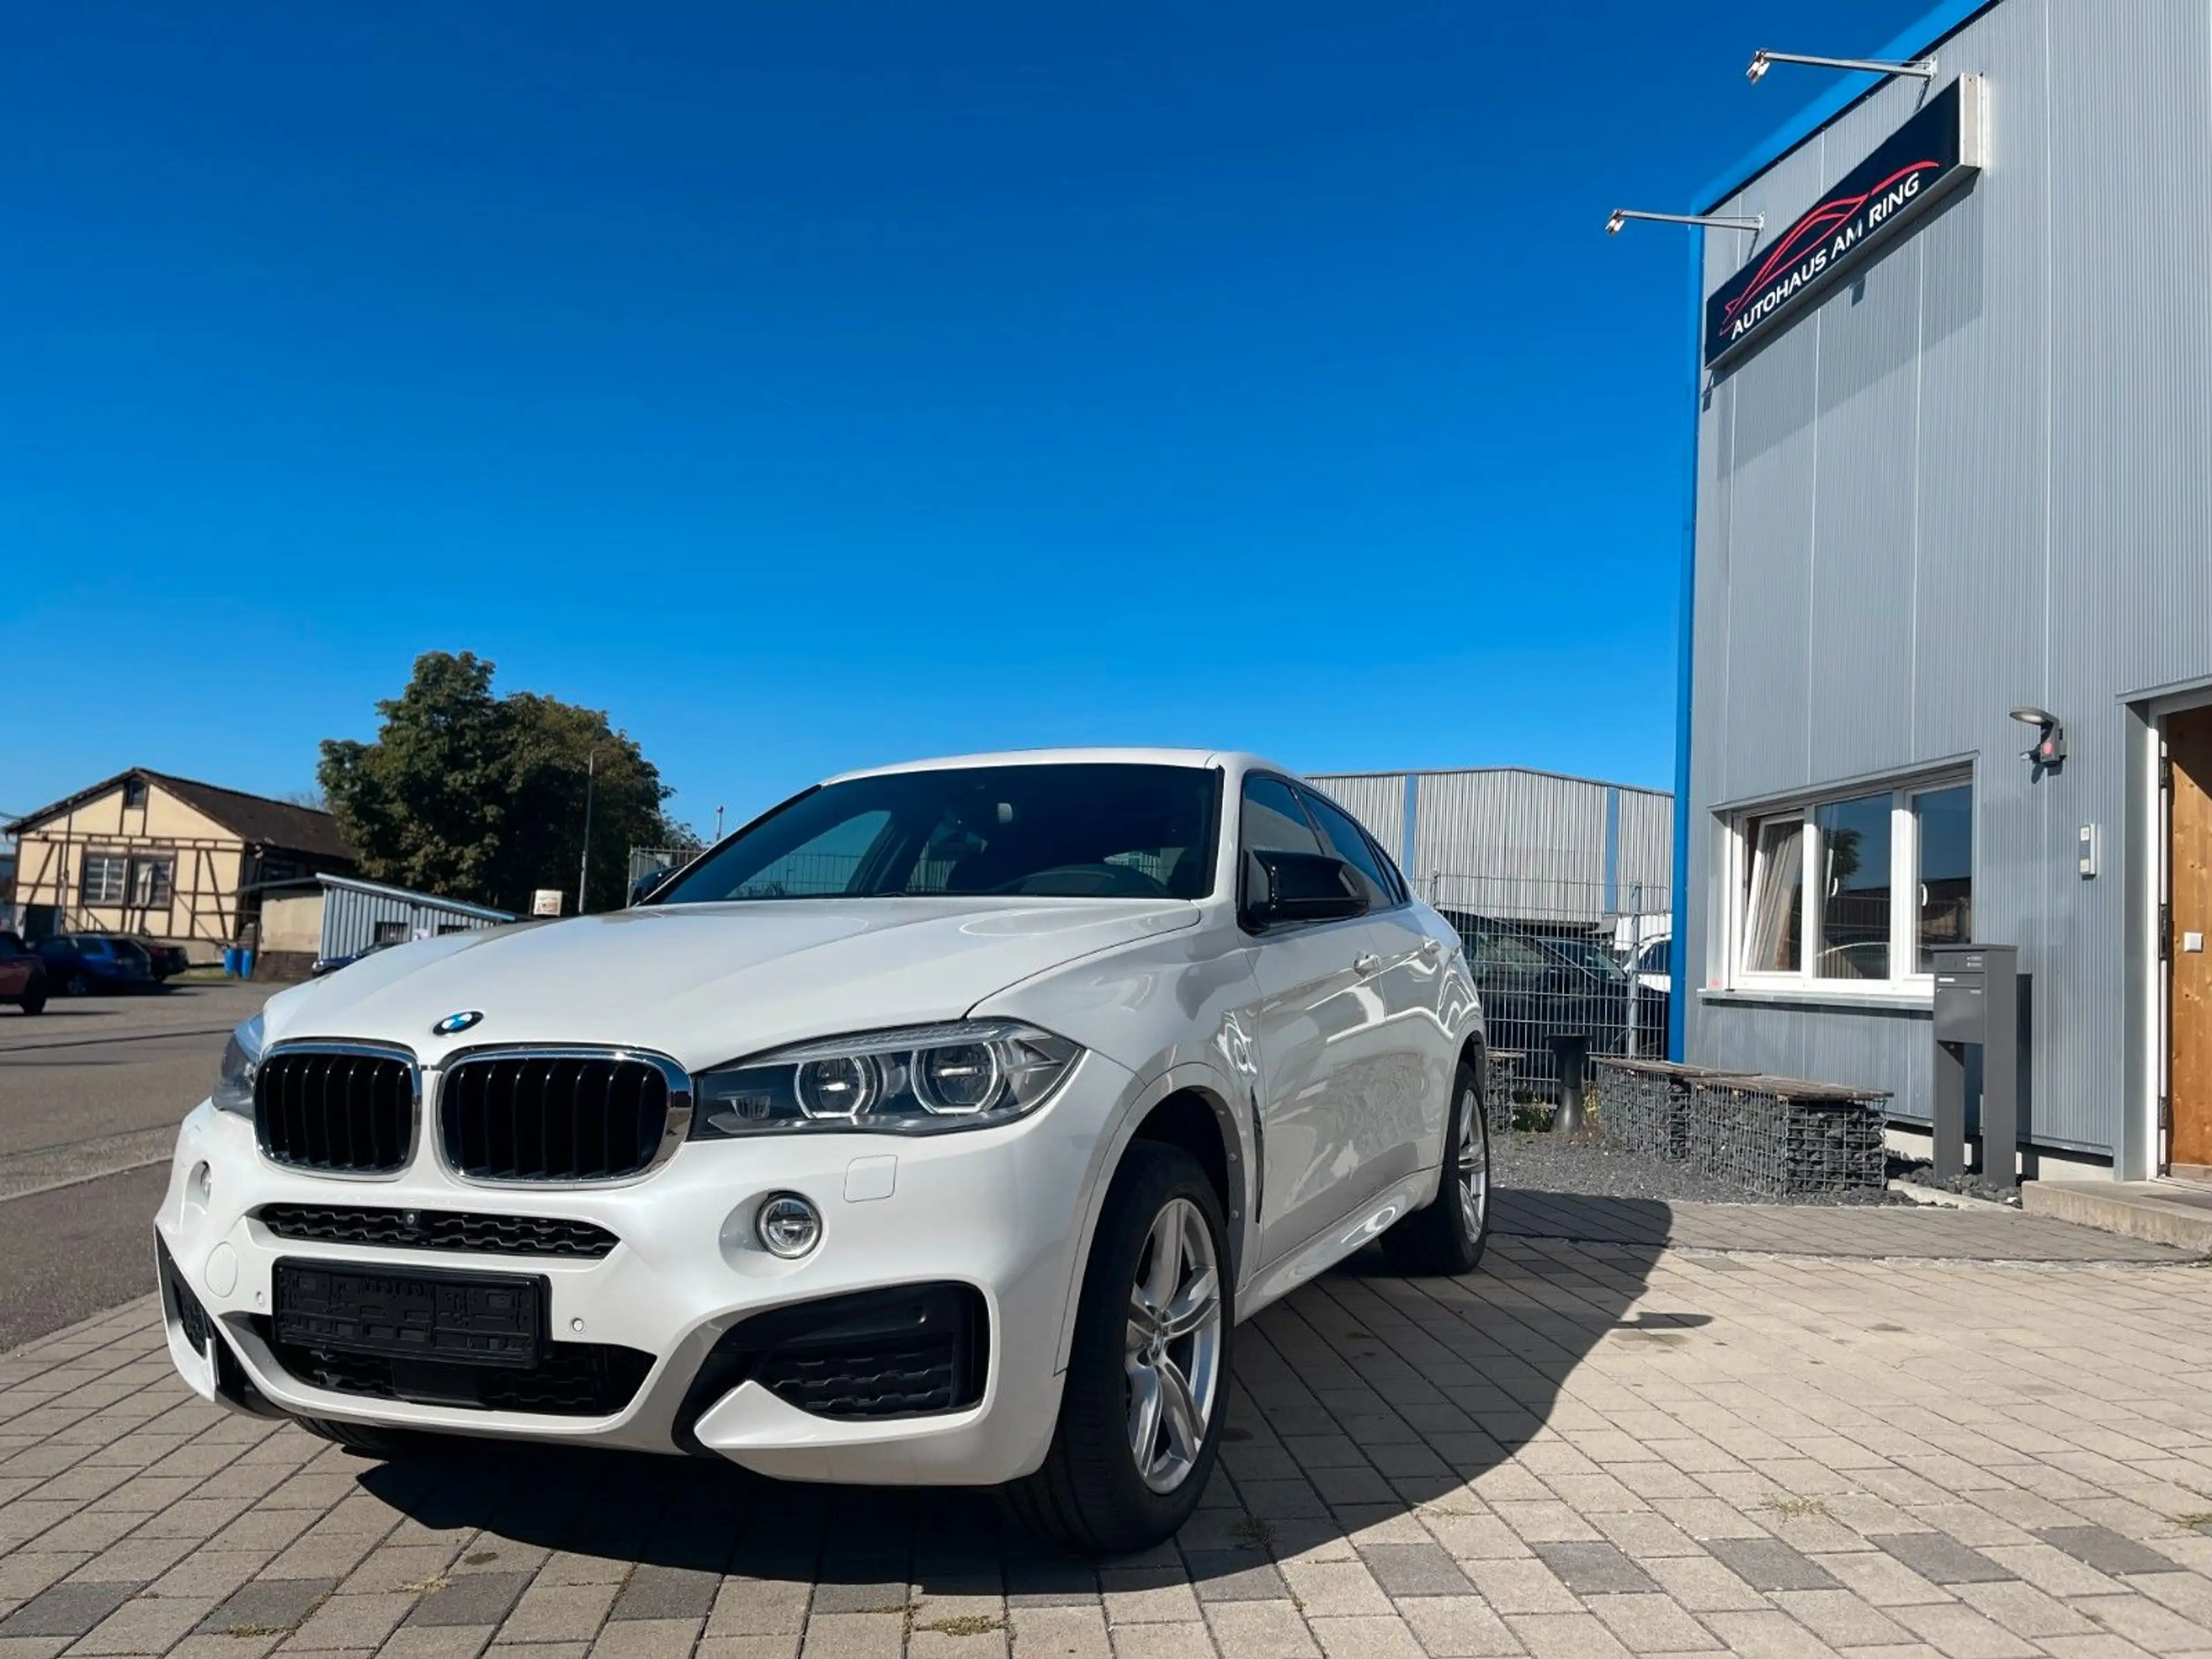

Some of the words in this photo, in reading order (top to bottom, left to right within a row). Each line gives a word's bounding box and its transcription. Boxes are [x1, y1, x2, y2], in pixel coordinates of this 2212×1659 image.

[1731, 249, 1827, 340] AUTOHAUS
[1831, 218, 1863, 259] AM
[1869, 172, 1919, 229] RING
